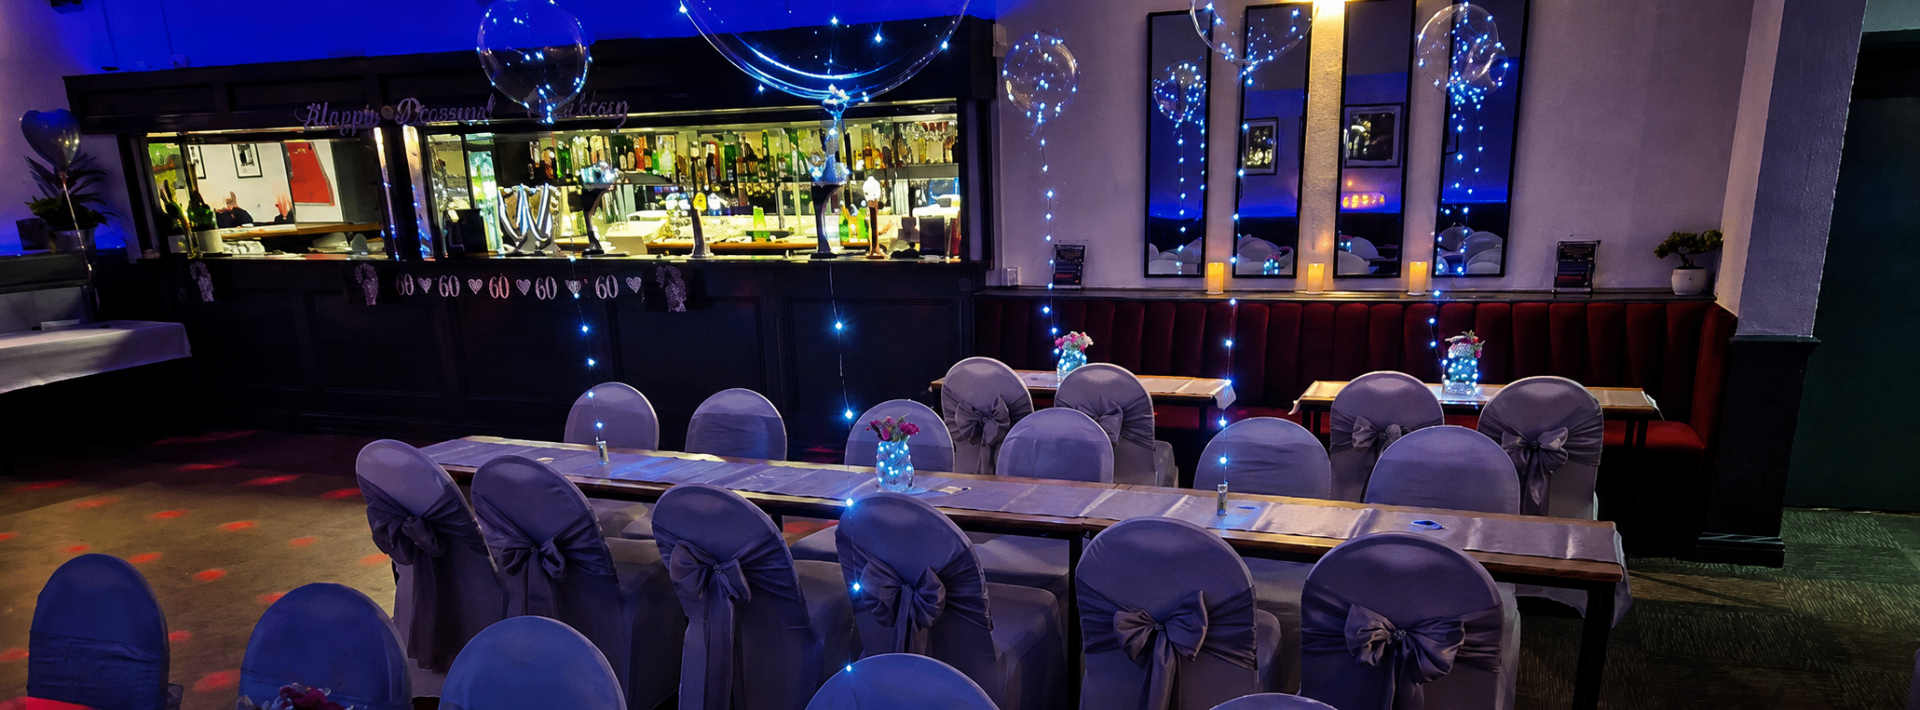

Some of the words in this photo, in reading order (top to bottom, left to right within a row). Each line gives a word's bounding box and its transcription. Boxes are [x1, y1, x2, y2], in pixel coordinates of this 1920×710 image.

[396, 273, 414, 296] 60
[438, 275, 461, 298] 60
[488, 275, 510, 299] 60
[535, 276, 558, 300] 60
[595, 274, 619, 299] 60
